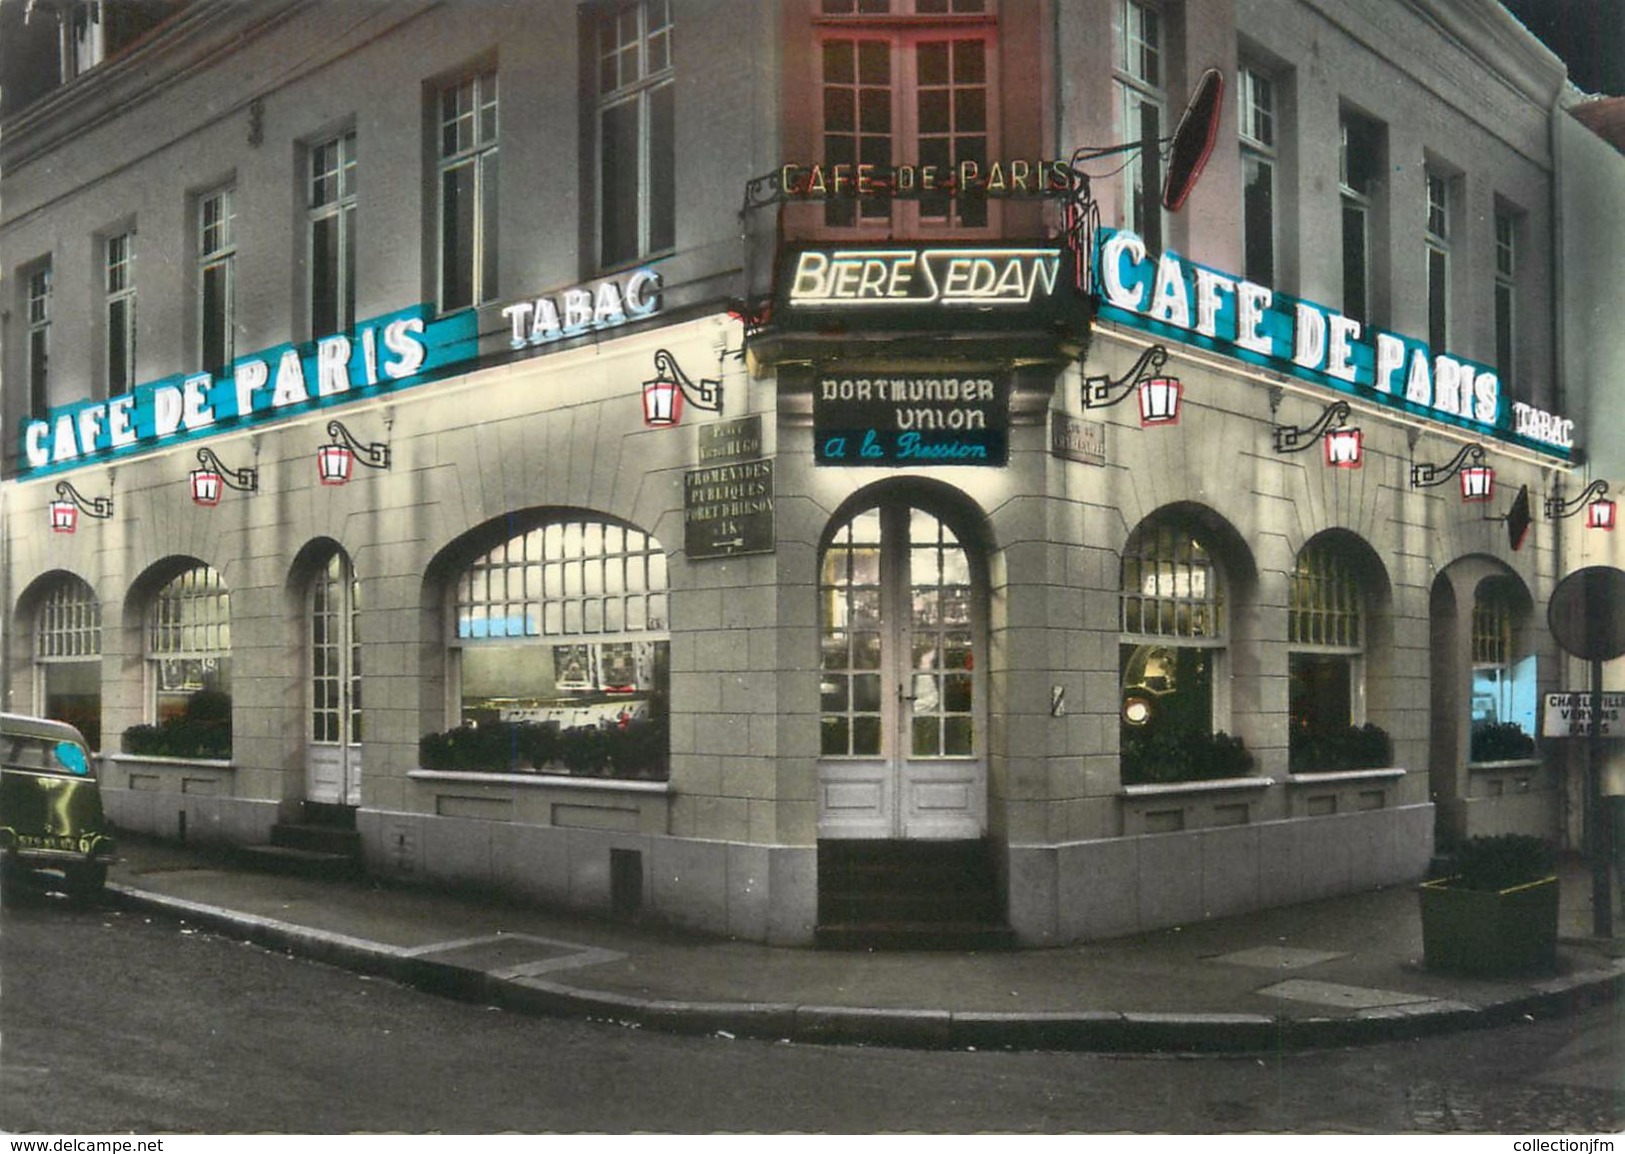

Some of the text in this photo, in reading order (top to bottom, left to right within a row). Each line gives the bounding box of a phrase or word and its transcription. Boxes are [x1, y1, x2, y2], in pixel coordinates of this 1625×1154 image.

[783, 160, 1070, 194] CAFE DE PARIS
[921, 249, 1061, 304] SEDAN
[502, 268, 662, 349] TABAC
[1101, 231, 1499, 424] CAFE DE PARIS
[25, 317, 427, 468] CAFE DE PARIS
[821, 378, 995, 401] DORTMUNDER
[1512, 401, 1575, 448] TABAC
[897, 431, 988, 458] Pression
[687, 463, 770, 486] PROMENADES
[691, 483, 765, 503] PUBLIQUES
[1549, 696, 1625, 708] CHARLILL
[1561, 709, 1618, 721] VERVNS
[1569, 723, 1609, 734] PARS
